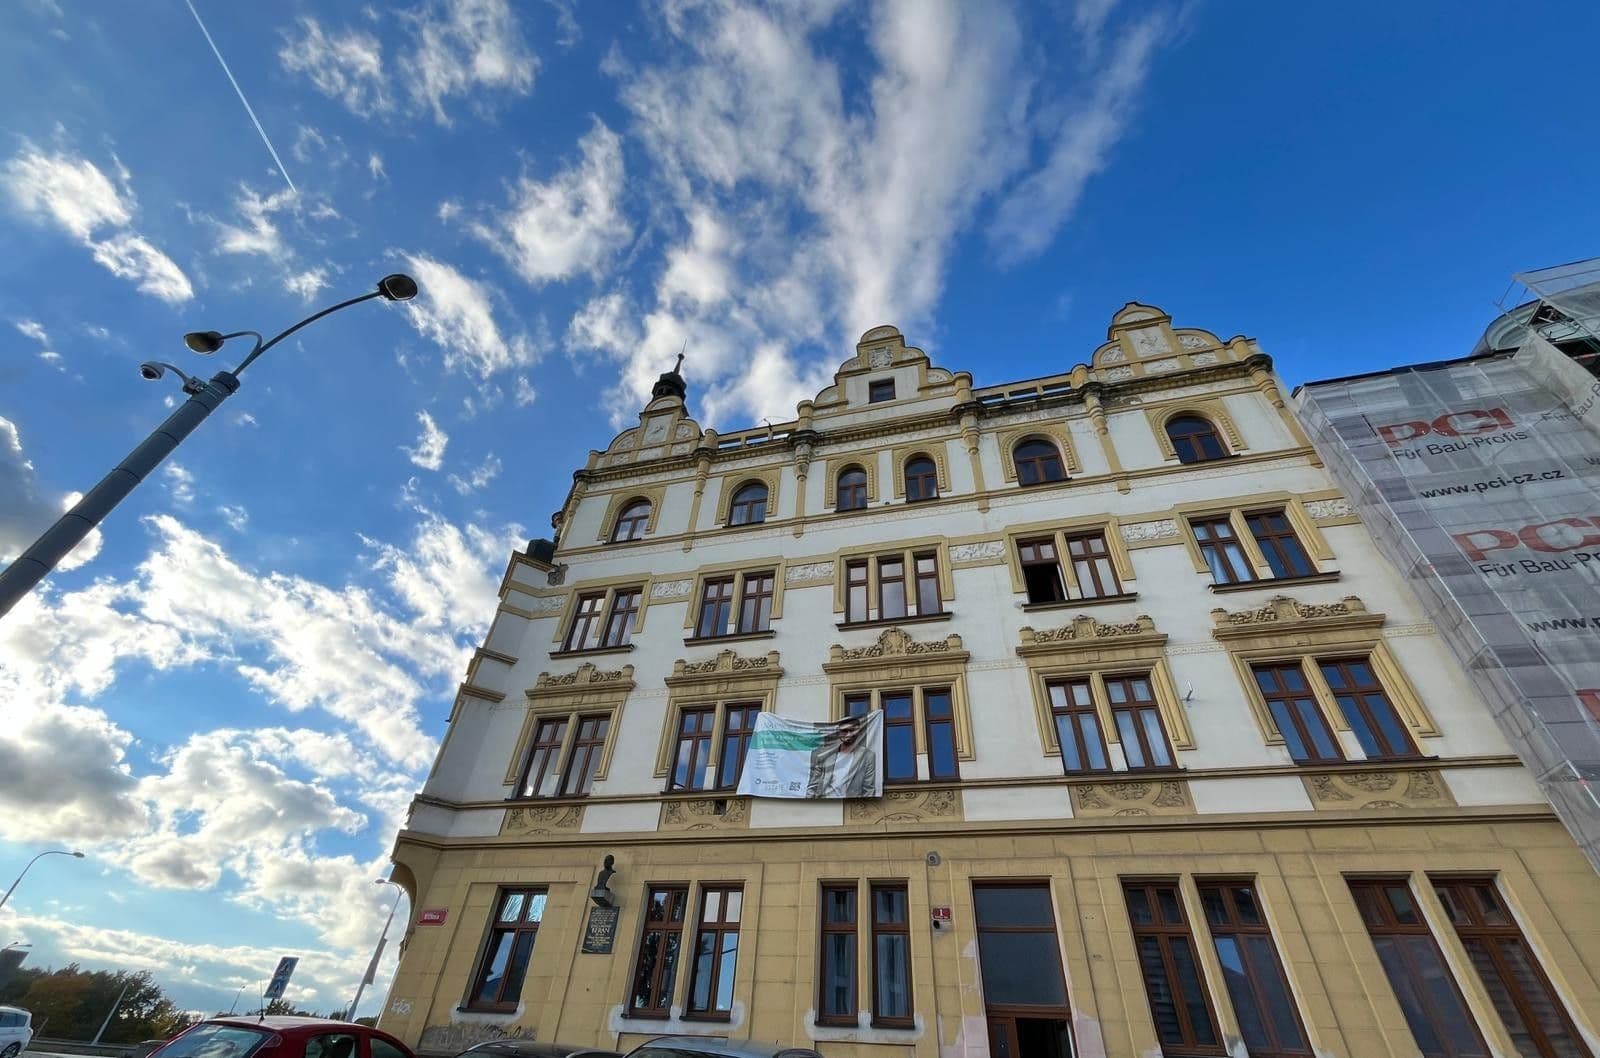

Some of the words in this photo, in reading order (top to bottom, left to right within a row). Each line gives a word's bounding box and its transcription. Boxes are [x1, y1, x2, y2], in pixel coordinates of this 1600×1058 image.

[1377, 407, 1516, 447] PCI
[1393, 447, 1422, 461] Für
[1426, 430, 1529, 456] Bau-Profis
[1420, 469, 1566, 499] www.pci-cz.cz
[1479, 563, 1517, 578] Für
